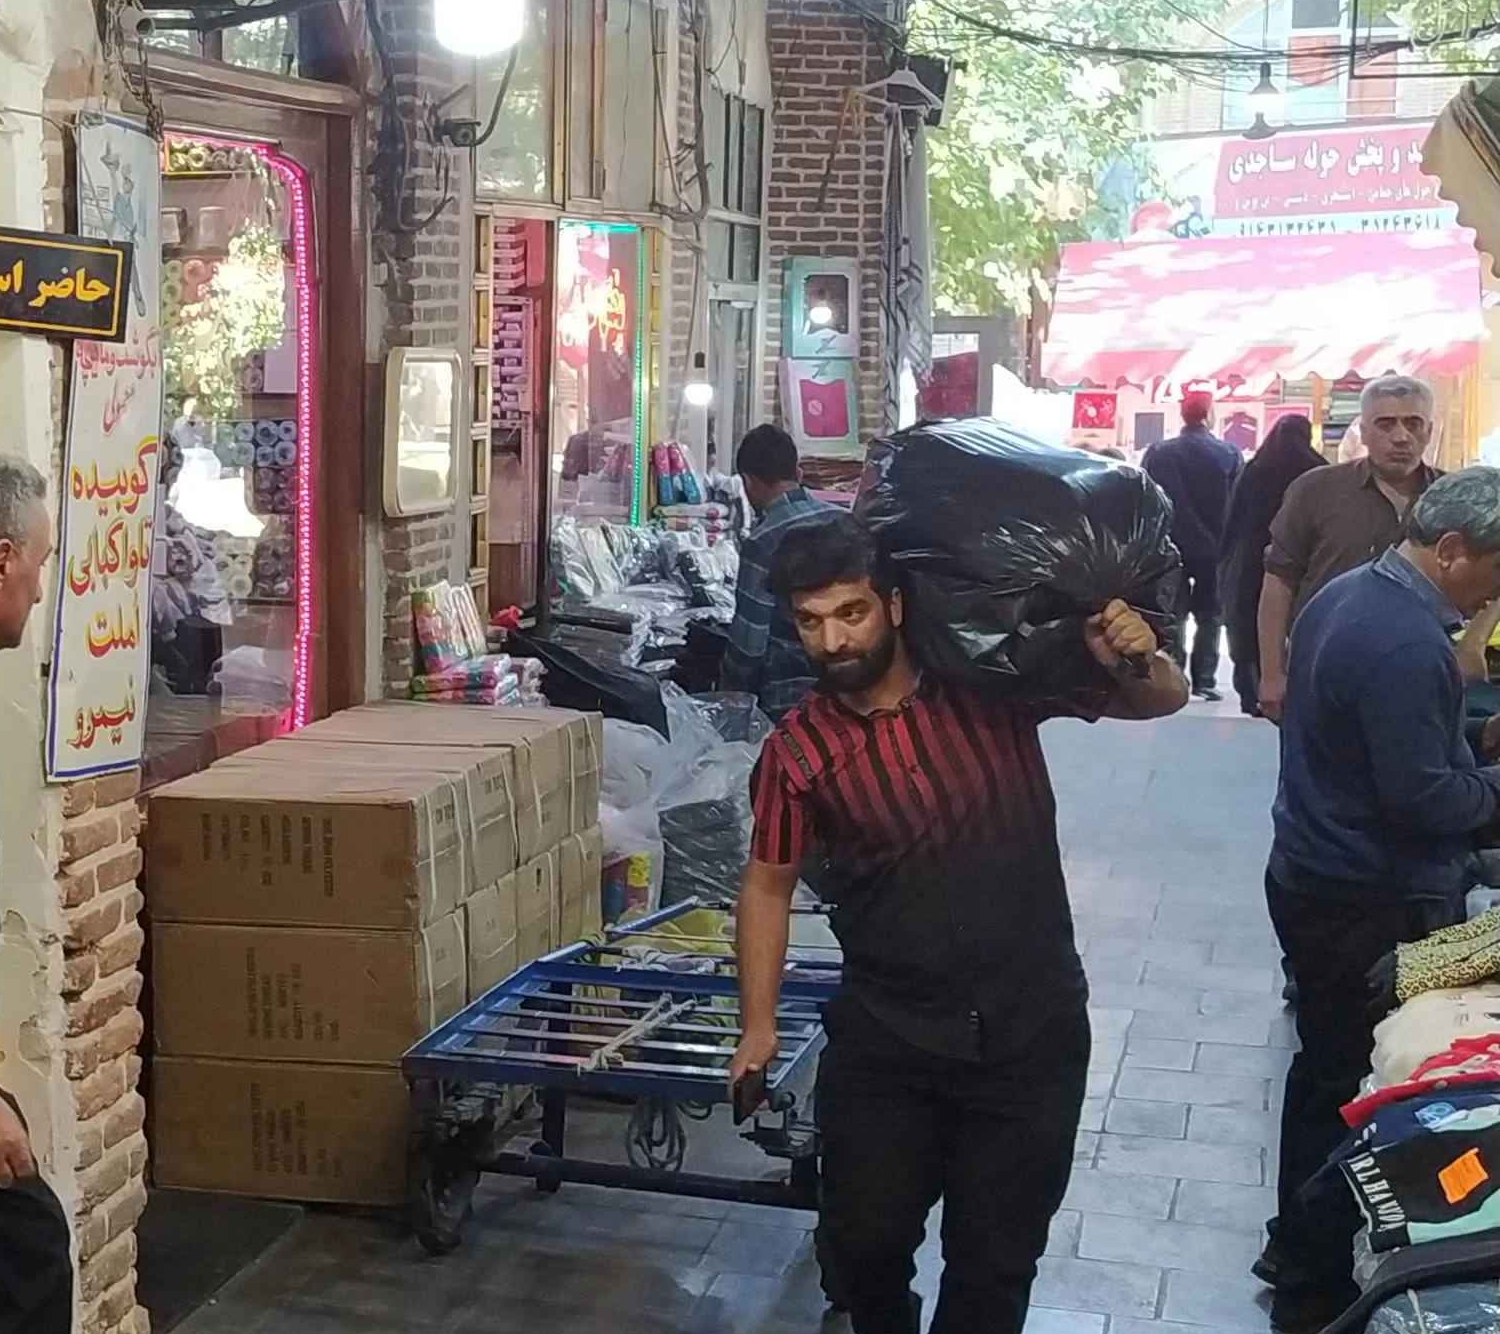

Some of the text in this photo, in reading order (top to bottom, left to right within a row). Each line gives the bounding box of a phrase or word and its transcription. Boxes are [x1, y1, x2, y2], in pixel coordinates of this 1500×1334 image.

[1228, 142, 1297, 185] ساجدی
[1302, 139, 1340, 179] حوله
[1346, 135, 1384, 176] پخش
[28, 266, 111, 308] حاضر
[69, 435, 158, 517] کوبیده
[66, 673, 136, 750] نیمرو
